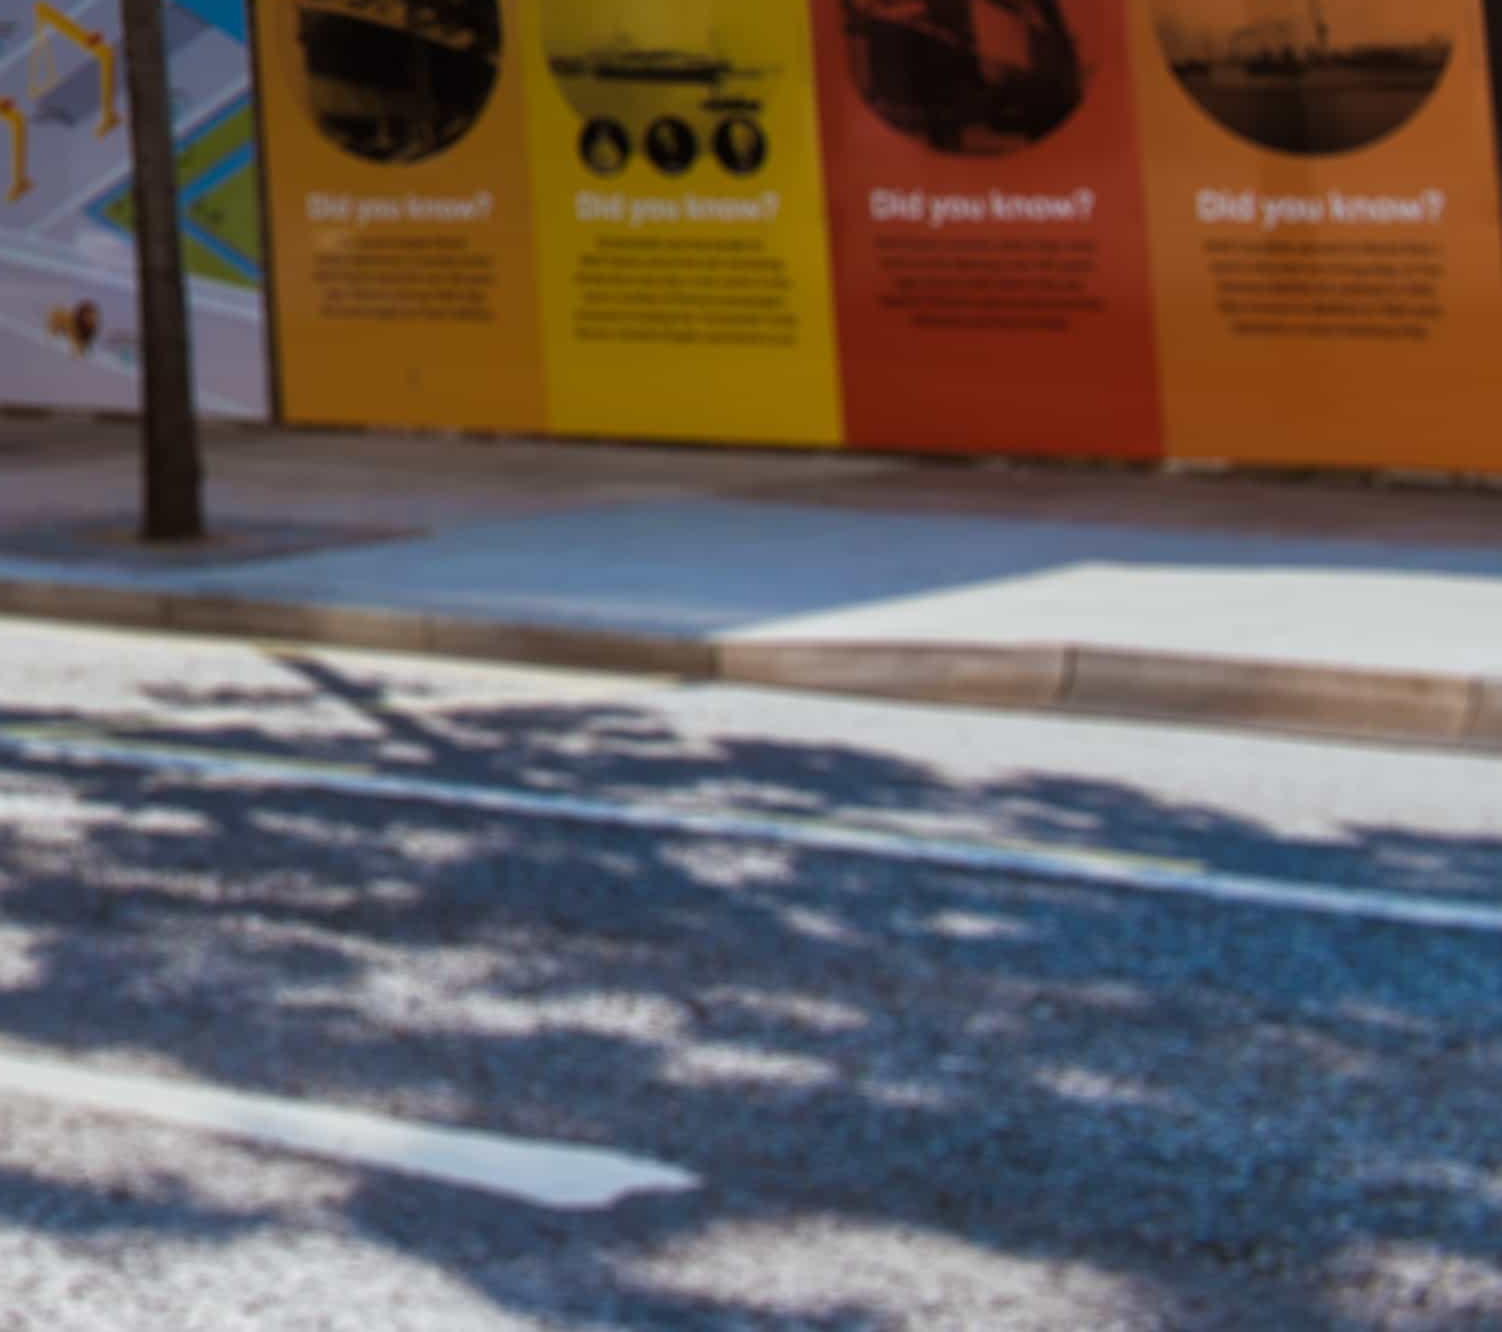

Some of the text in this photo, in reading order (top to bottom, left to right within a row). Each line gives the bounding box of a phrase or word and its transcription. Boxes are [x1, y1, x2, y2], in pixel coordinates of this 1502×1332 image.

[305, 193, 494, 229] Did you know?
[575, 191, 780, 228] Did you know?
[870, 189, 1096, 227] Did you know?
[1195, 190, 1447, 231] Did you know?
